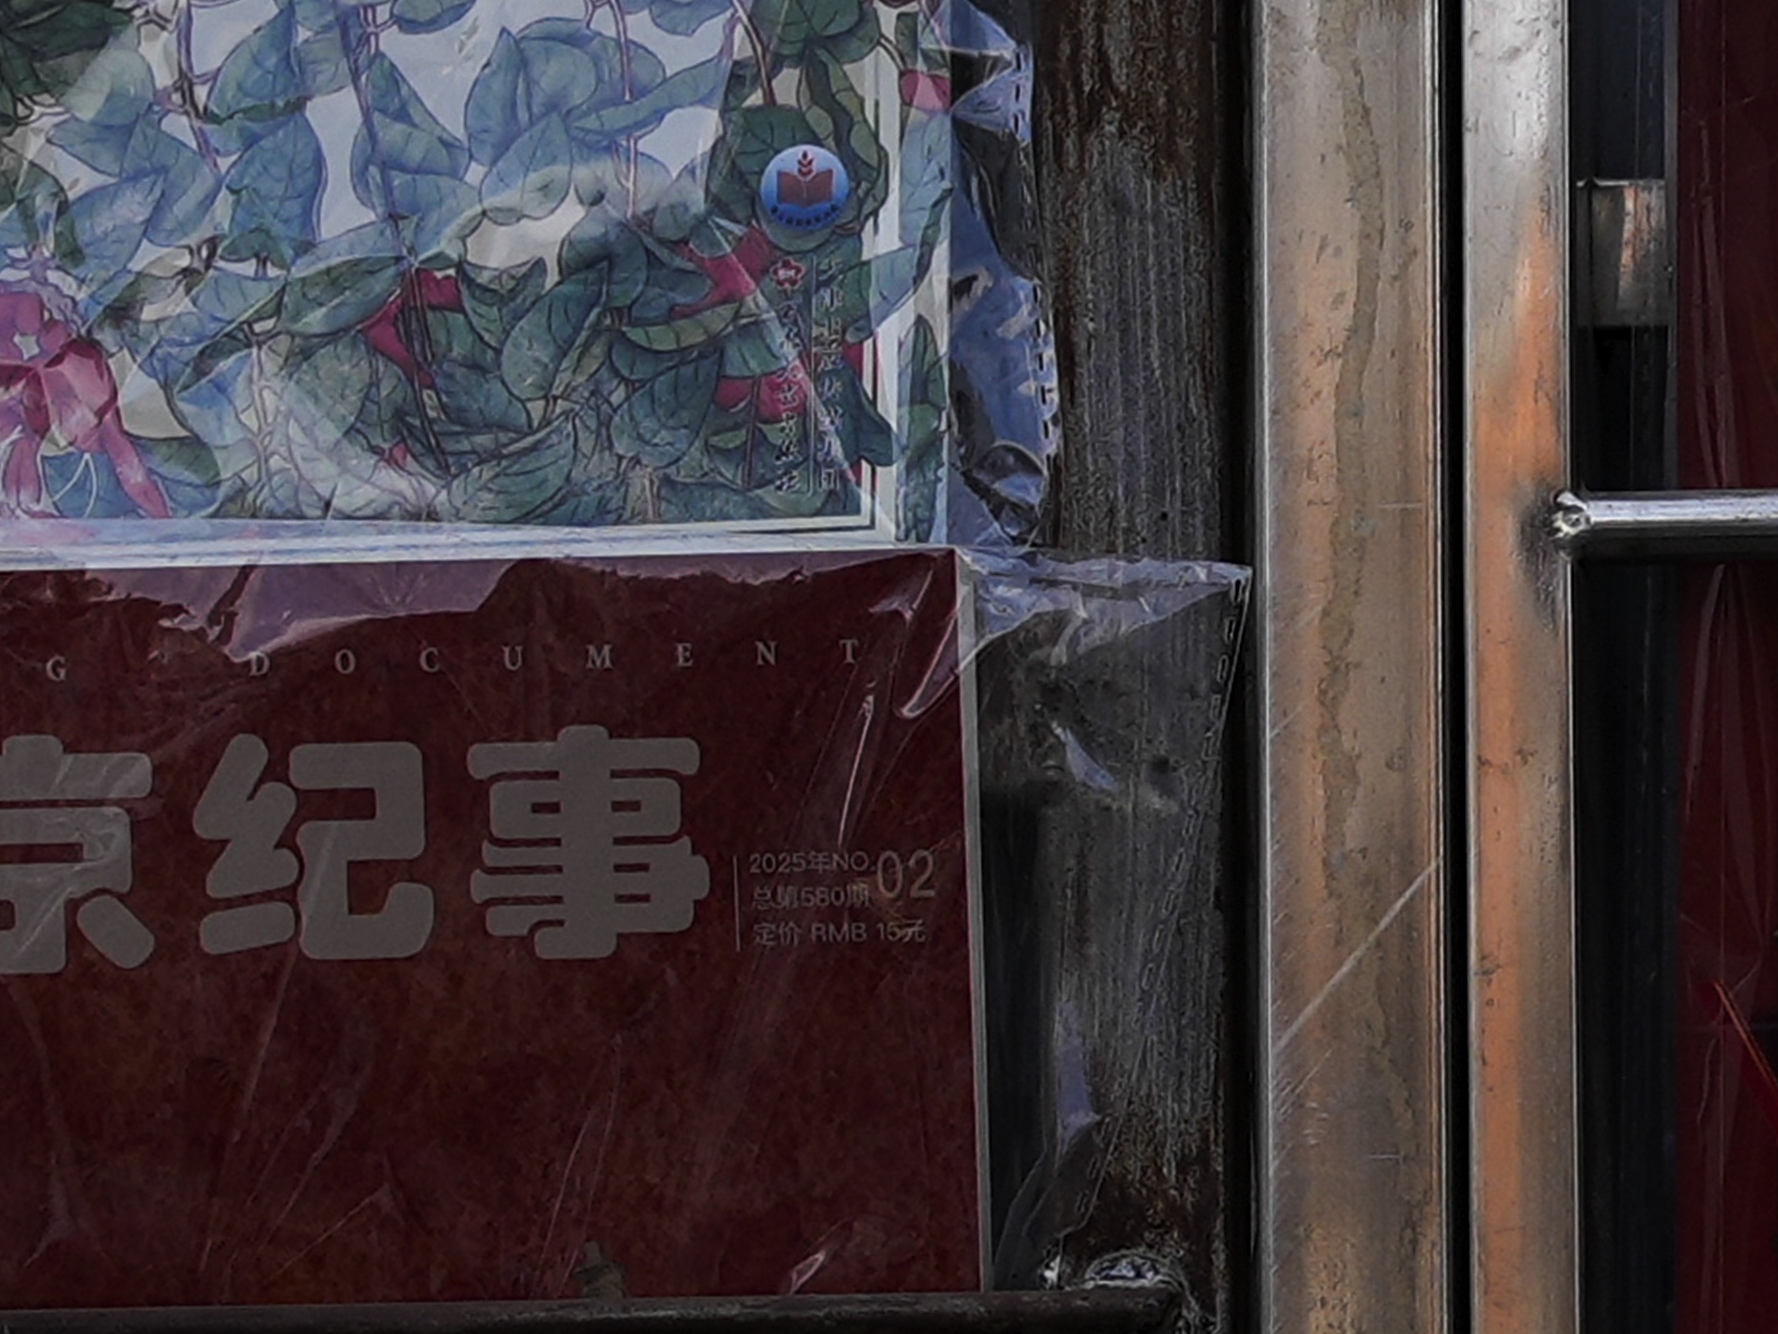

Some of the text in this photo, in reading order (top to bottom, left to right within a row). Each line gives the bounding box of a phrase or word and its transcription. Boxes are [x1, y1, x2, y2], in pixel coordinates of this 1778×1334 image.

[0, 724, 711, 975] 京纪事
[878, 849, 937, 900] 02
[811, 923, 867, 944] RMB
